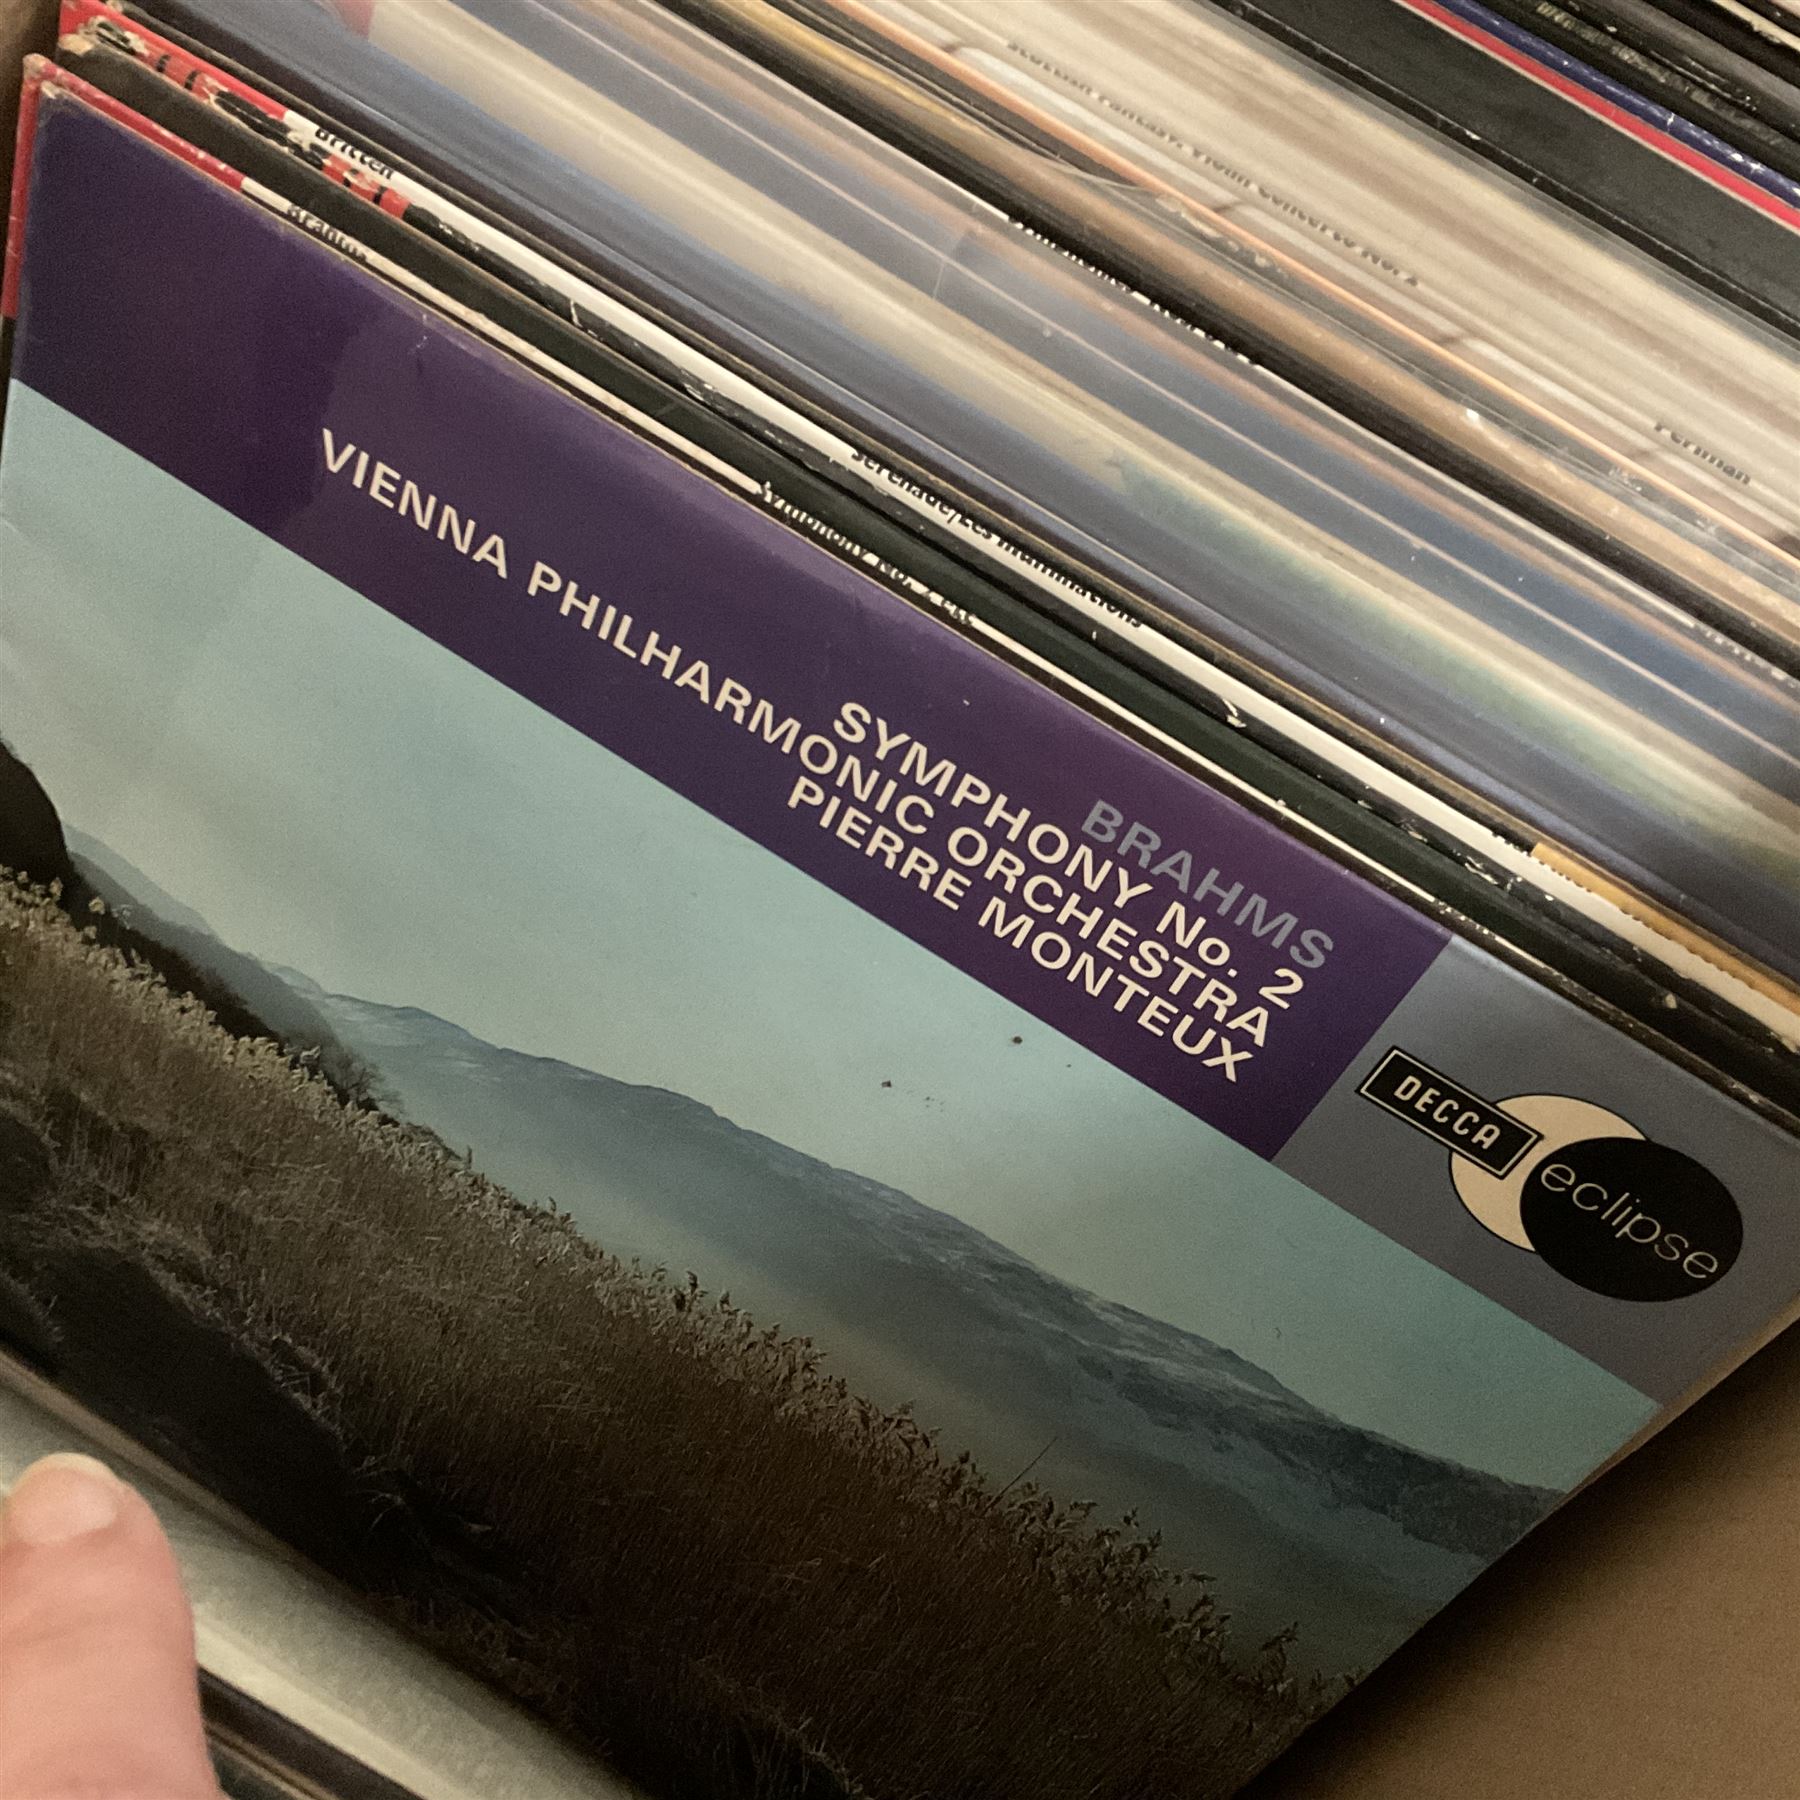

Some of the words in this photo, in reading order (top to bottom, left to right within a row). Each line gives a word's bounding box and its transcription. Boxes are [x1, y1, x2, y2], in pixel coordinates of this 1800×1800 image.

[322, 428, 508, 579] VIENNA
[526, 561, 935, 835] PHILHARMONIC
[946, 826, 1269, 1048] ORCHESTRA
[833, 701, 1154, 909] SYMPHONY
[1156, 901, 1238, 978] No.
[1259, 967, 1305, 1009] 2
[787, 775, 973, 911] PIERRE
[978, 896, 1254, 1083] MONTEUX
[1081, 799, 1335, 969] BRAHMS
[1393, 1074, 1502, 1150] DECCA
[1539, 1162, 1719, 1279] eclipse
